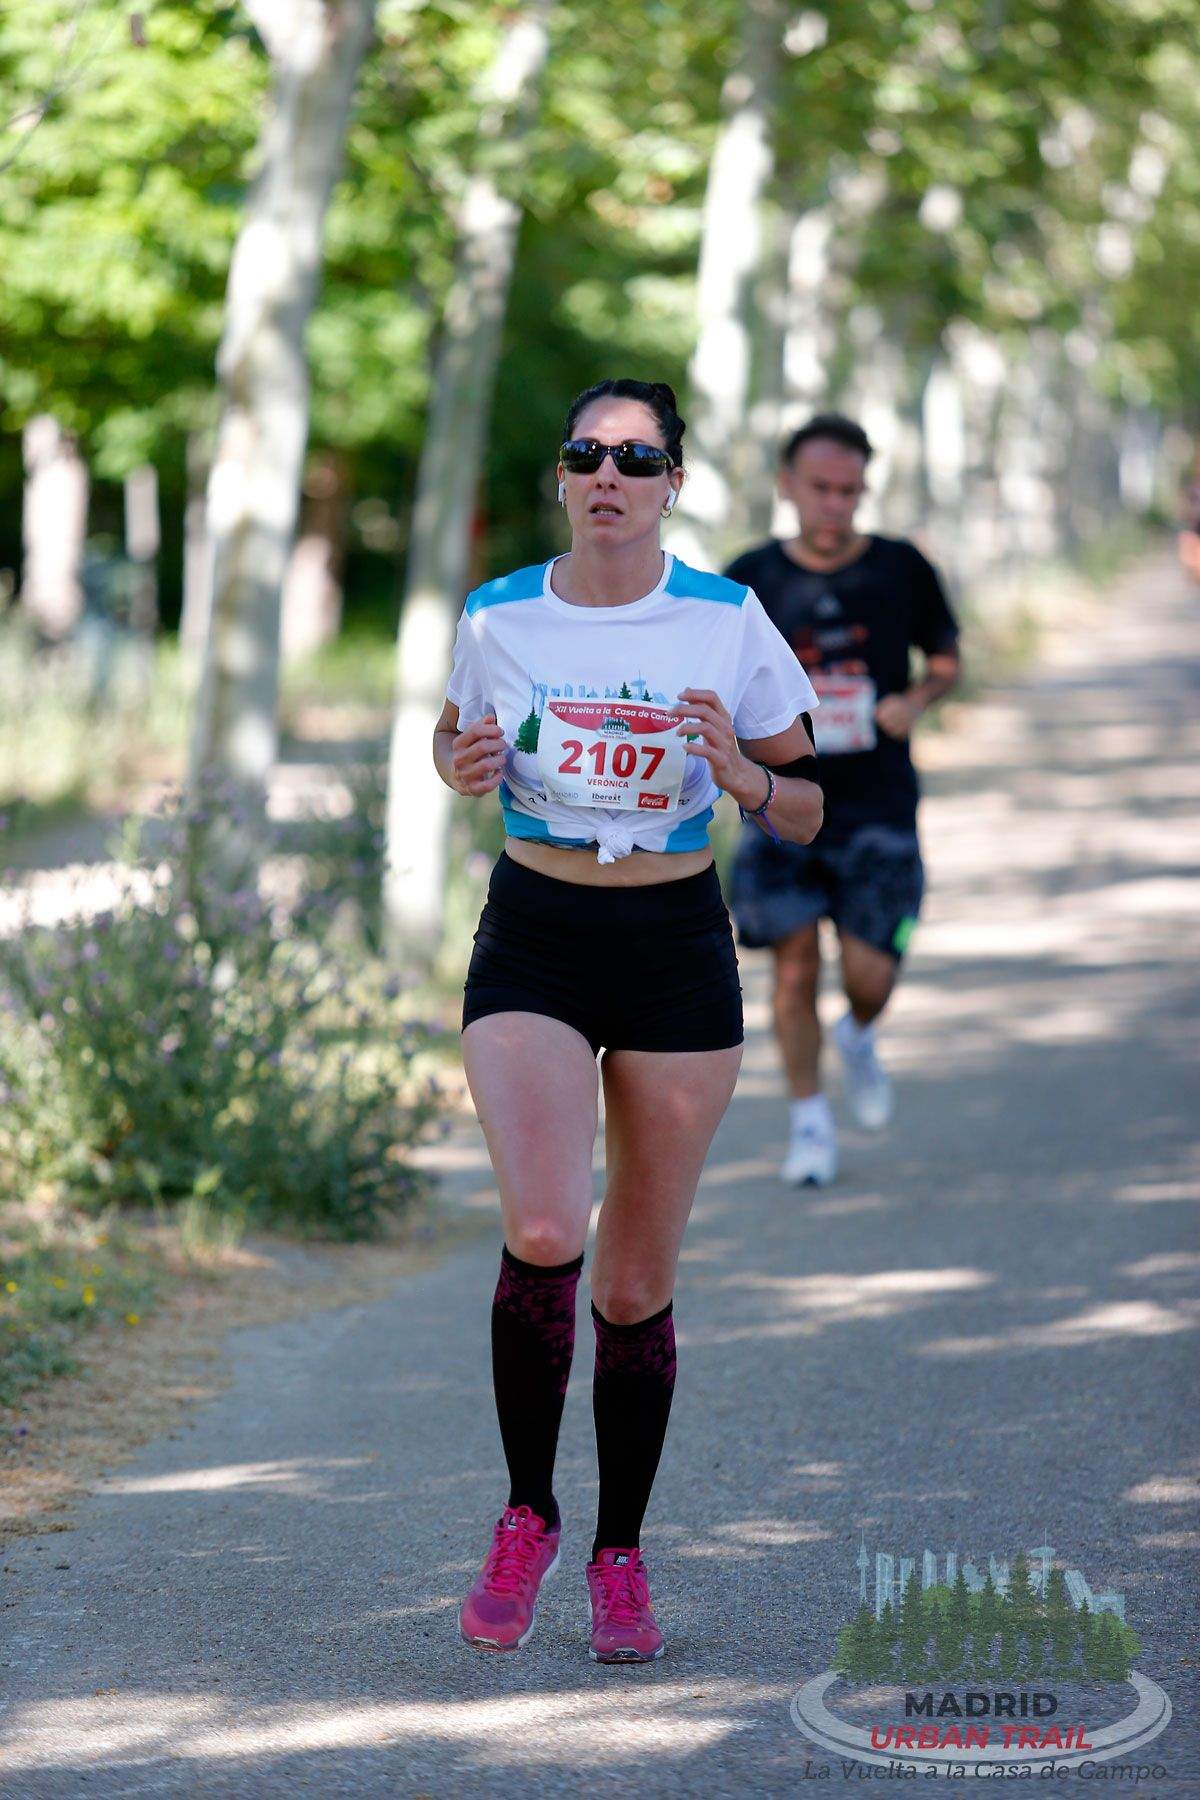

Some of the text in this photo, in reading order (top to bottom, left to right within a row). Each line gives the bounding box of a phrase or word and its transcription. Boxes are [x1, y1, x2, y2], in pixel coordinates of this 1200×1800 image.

[555, 705, 567, 713] XII
[568, 706, 595, 714] Vuelta
[614, 707, 636, 717] Casa
[638, 709, 649, 718] de
[558, 739, 666, 781] 2107
